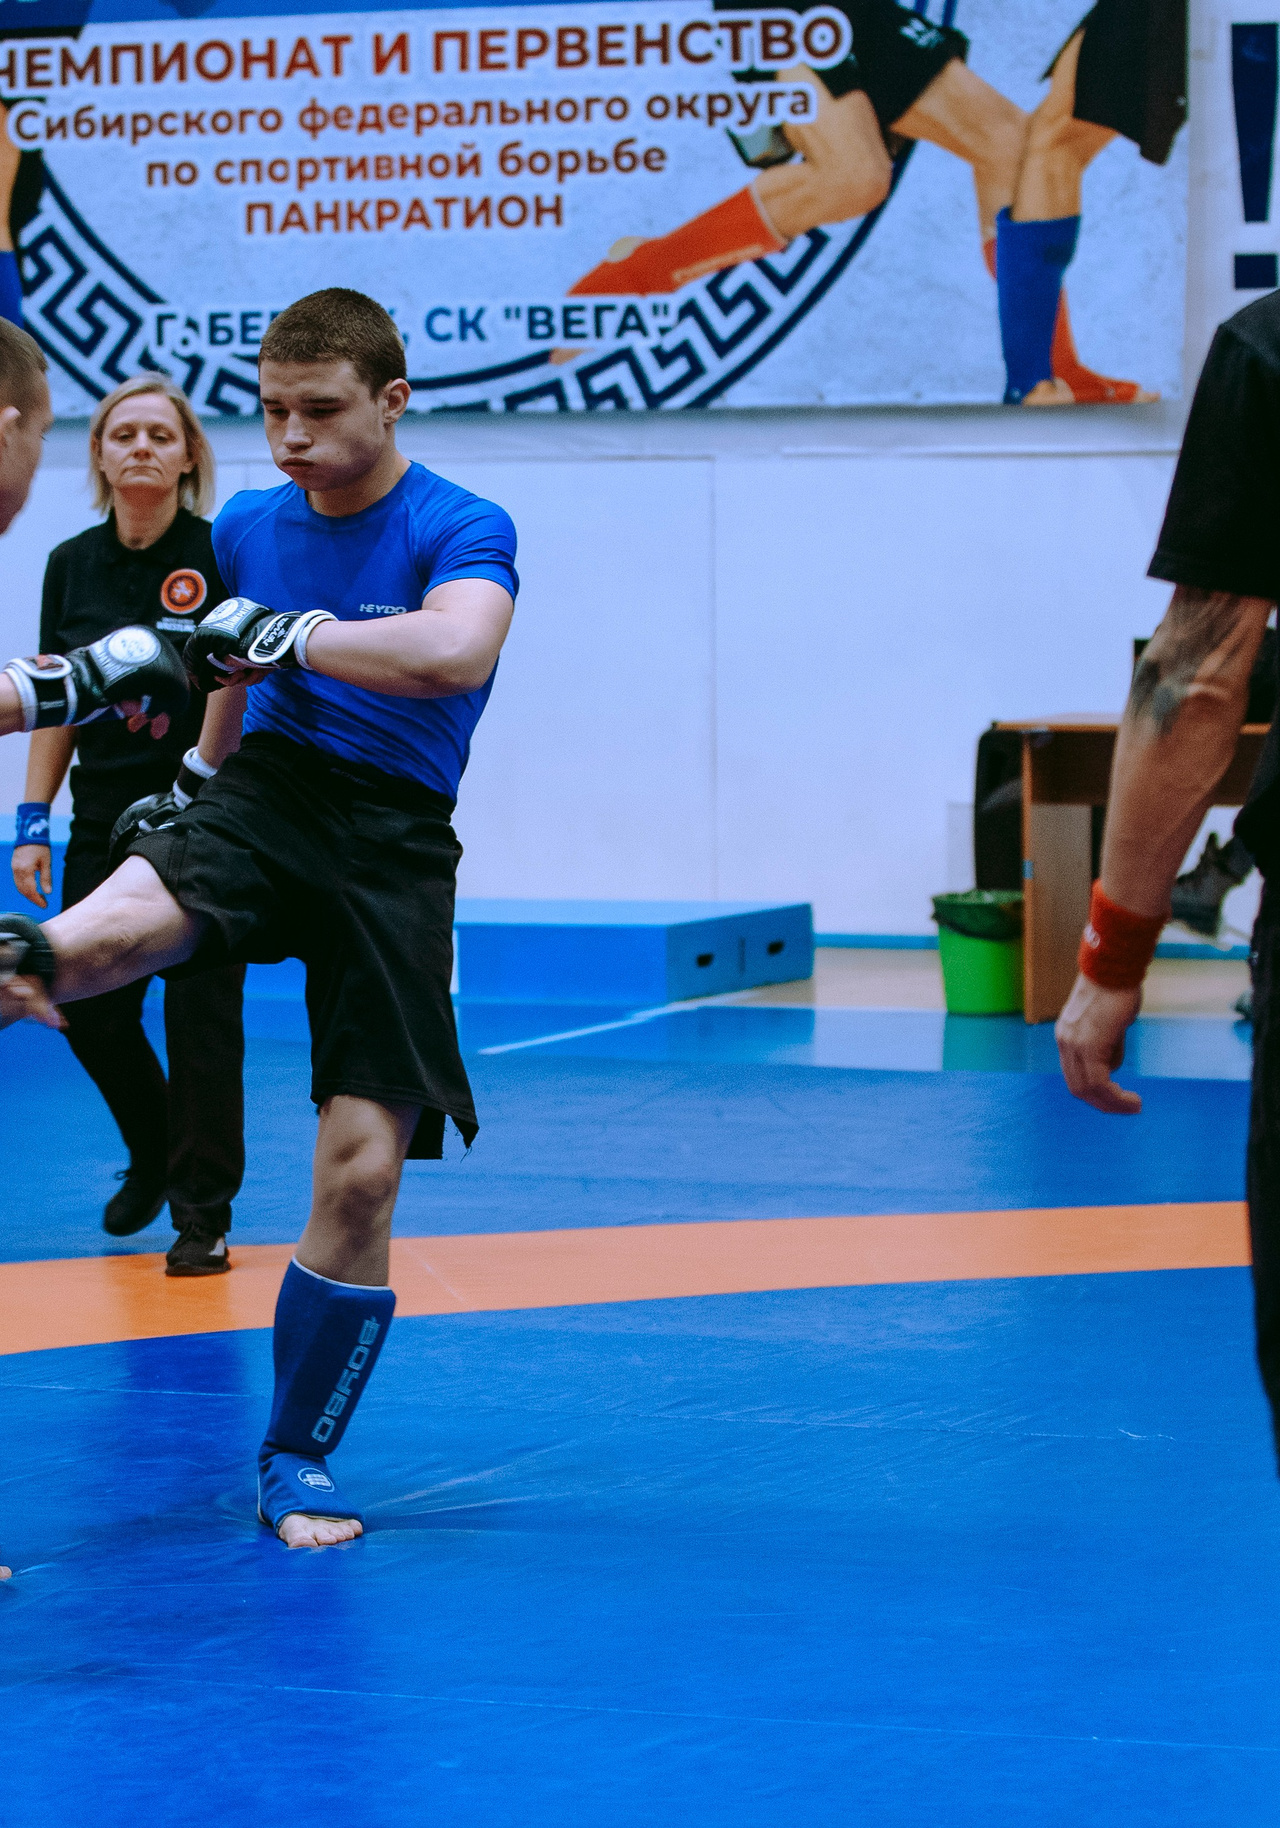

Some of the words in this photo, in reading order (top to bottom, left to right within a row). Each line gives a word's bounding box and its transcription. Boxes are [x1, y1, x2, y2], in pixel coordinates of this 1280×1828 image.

[372, 33, 410, 75] И
[433, 16, 843, 73] ПЕРВЕНСТВО
[15, 104, 283, 145] Сибирского
[298, 95, 630, 141] федерального
[645, 90, 810, 127] округа
[147, 160, 198, 187] по
[214, 144, 480, 192] спортивной
[498, 139, 668, 184] борьбе
[245, 193, 565, 234] ПАНКРАТИОН
[424, 306, 488, 342] СК
[504, 303, 669, 340] "ВЕГА"
